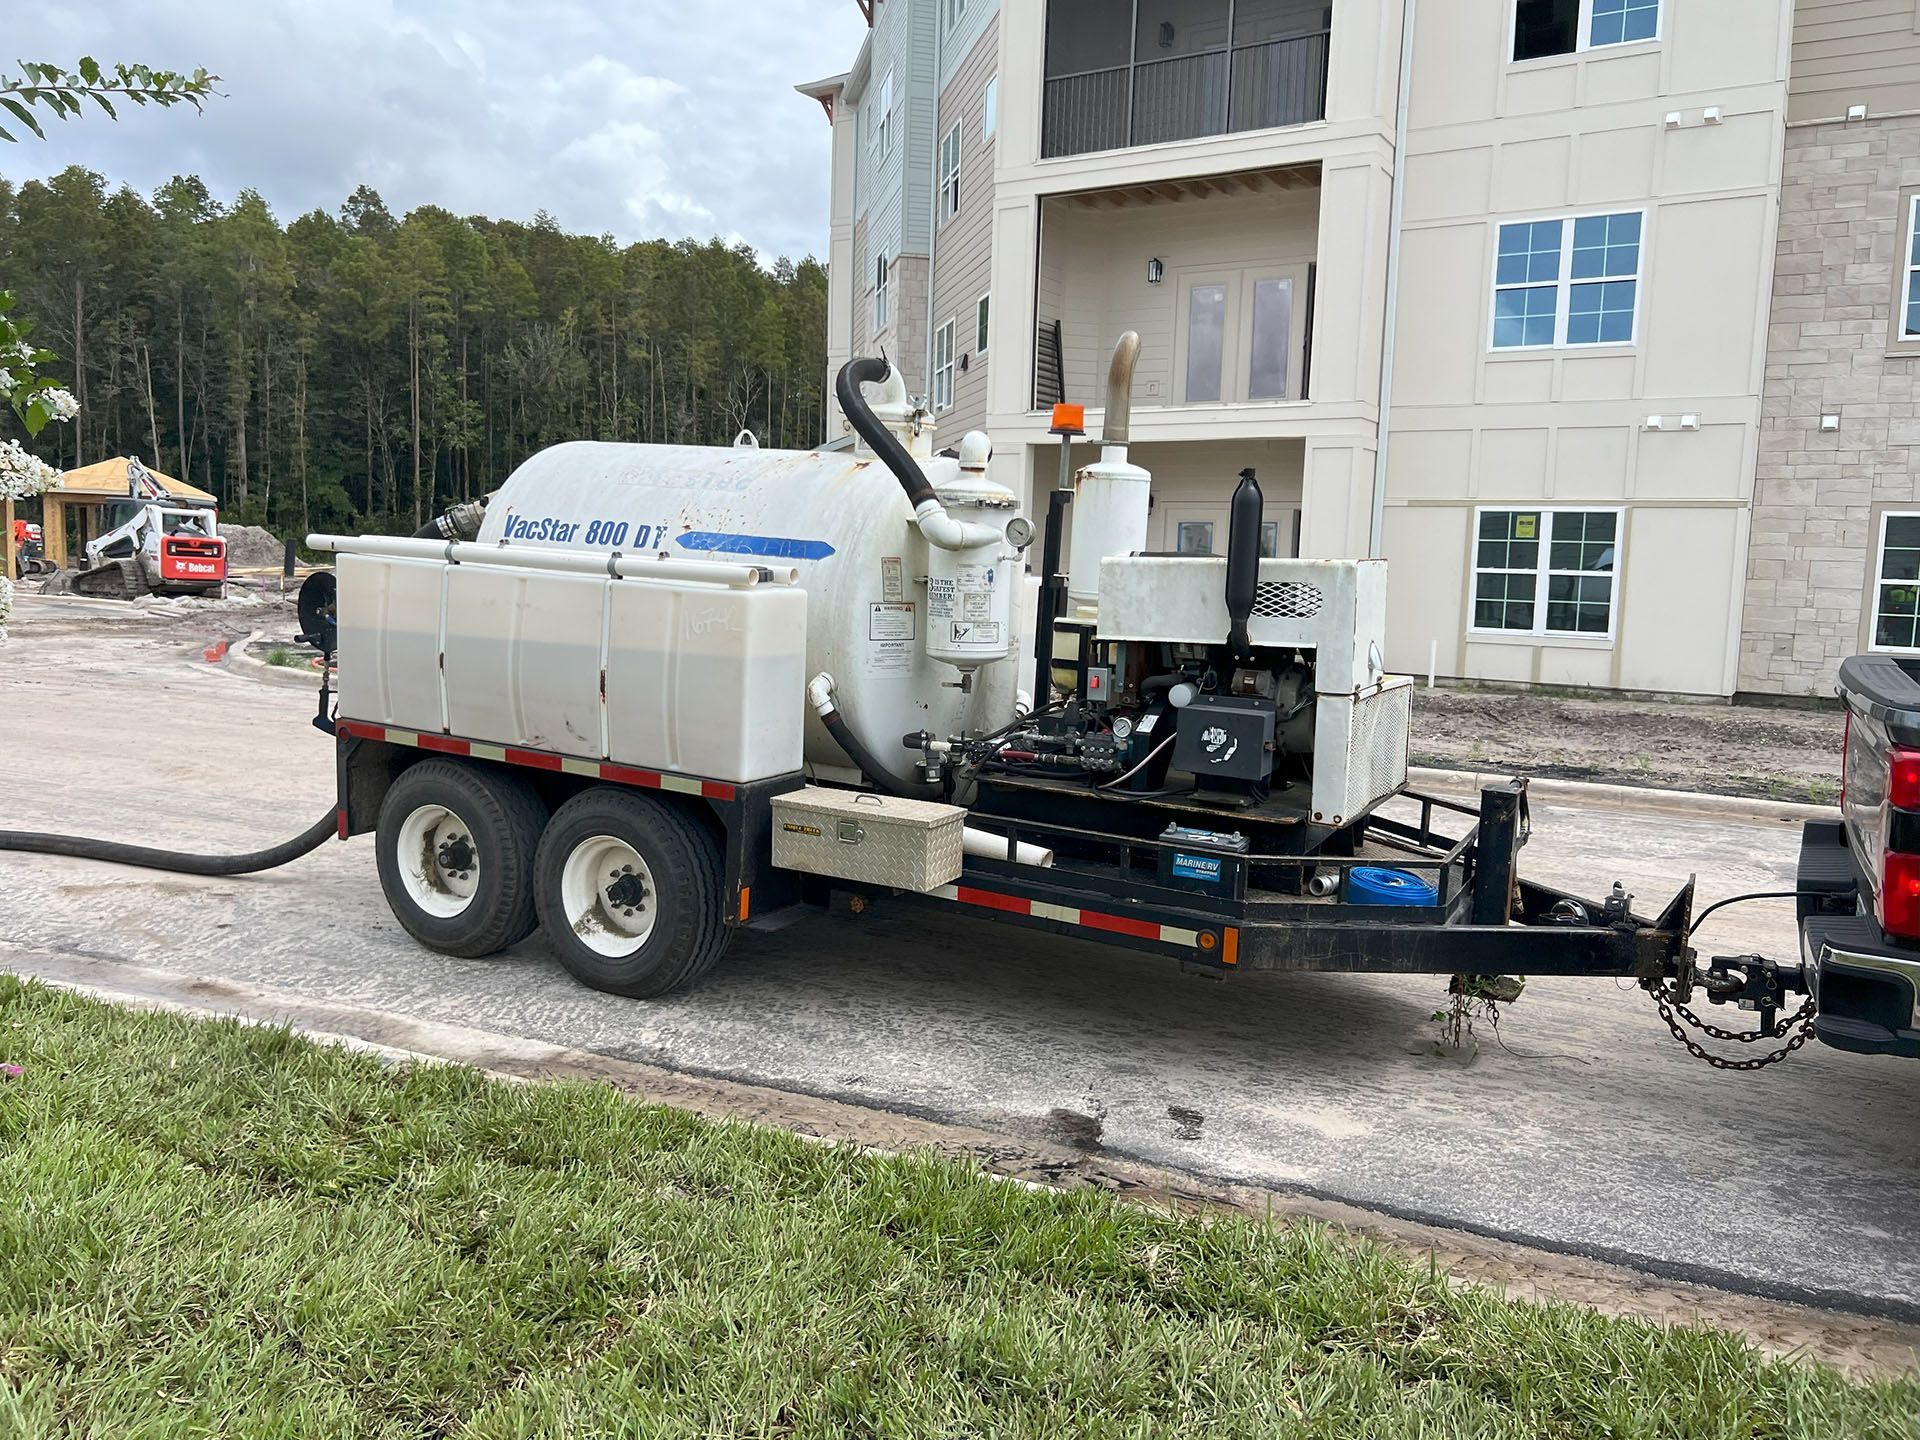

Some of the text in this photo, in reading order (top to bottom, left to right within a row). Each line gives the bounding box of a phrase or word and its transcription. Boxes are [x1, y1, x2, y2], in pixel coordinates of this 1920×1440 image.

[504, 514, 580, 543] VacStar
[585, 519, 629, 547] 800
[188, 562, 215, 573] Bobcat
[933, 585, 955, 593] SAFEST
